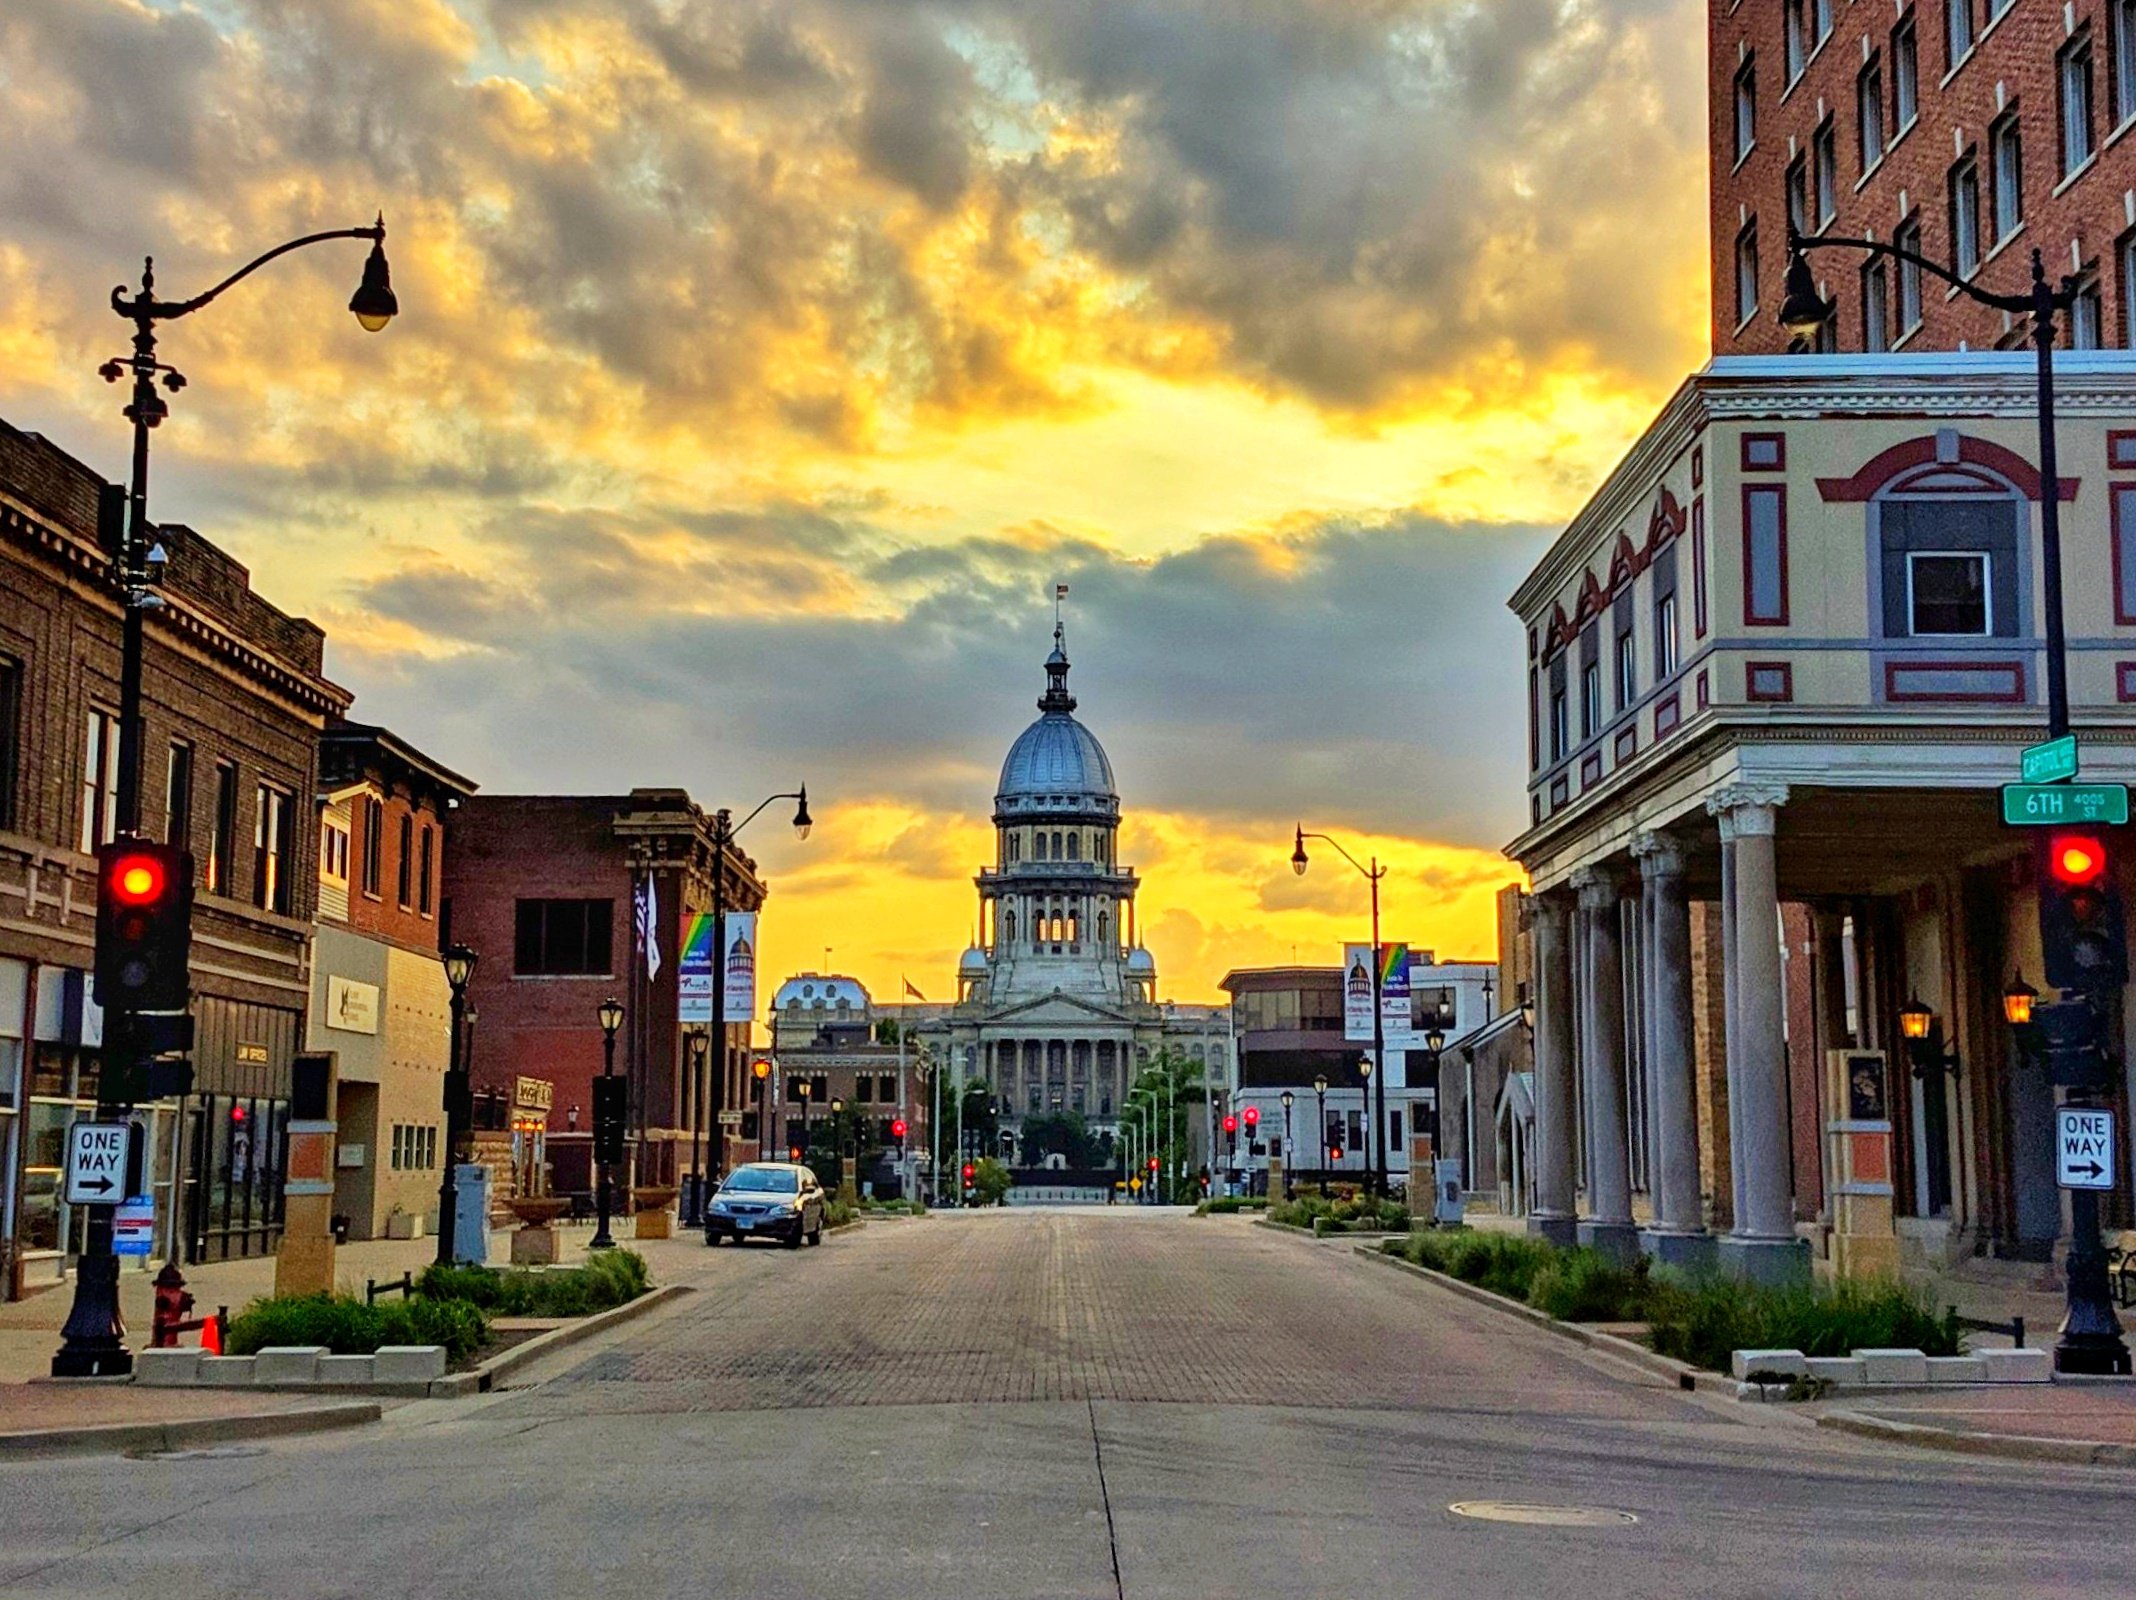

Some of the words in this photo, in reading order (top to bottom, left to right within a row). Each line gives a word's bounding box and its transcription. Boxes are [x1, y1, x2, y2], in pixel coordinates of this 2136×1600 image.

[2026, 794, 2063, 814] 6TH
[2083, 806, 2097, 817] ST
[2065, 1116, 2105, 1135] ONE
[81, 1132, 120, 1150] ONE
[2065, 1138, 2106, 1156] WAY
[79, 1153, 119, 1170] WAY
